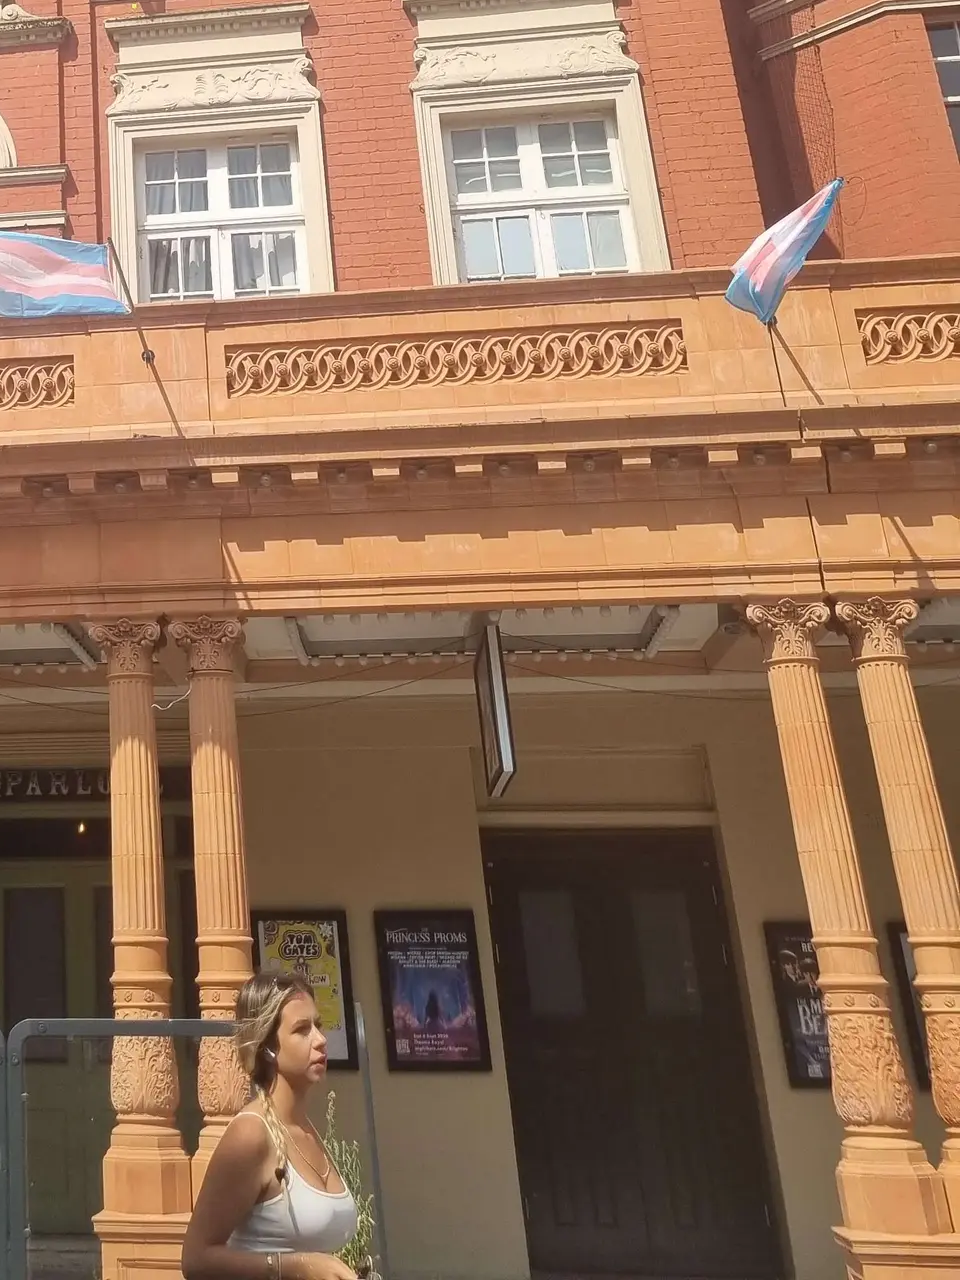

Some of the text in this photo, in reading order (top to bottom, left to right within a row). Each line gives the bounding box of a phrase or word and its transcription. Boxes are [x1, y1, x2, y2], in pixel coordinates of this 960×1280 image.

[5, 770, 111, 797] PARLO
[287, 934, 314, 945] TOM
[385, 931, 468, 944] PRINCESS PROMS
[284, 945, 318, 956] GATES
